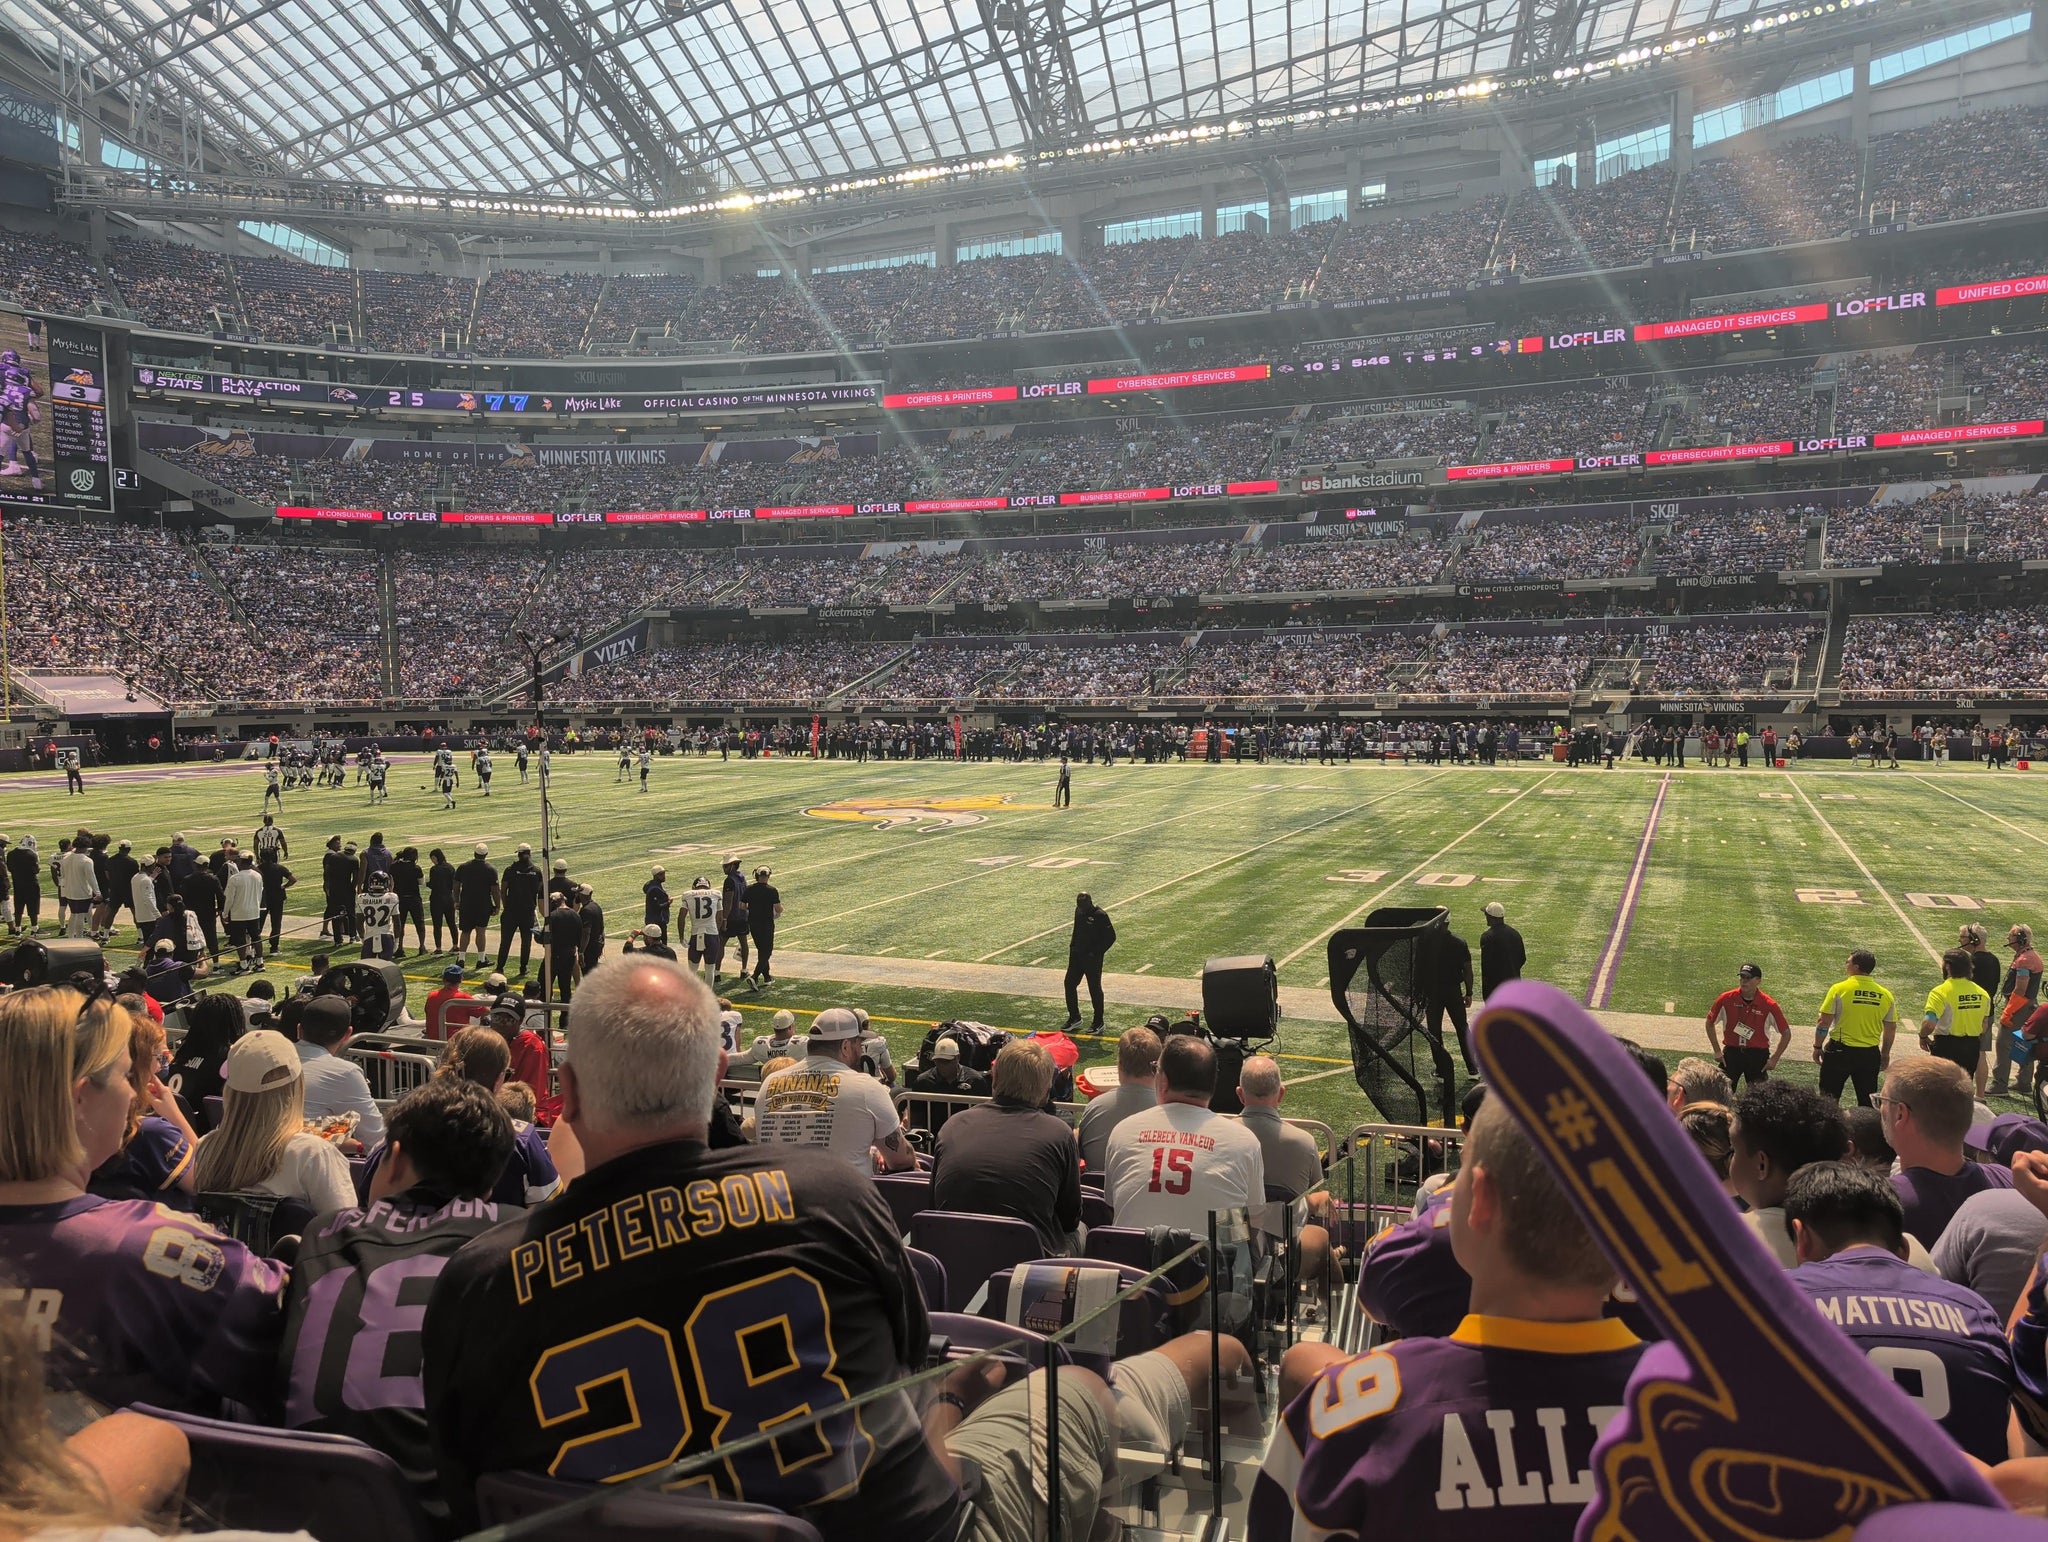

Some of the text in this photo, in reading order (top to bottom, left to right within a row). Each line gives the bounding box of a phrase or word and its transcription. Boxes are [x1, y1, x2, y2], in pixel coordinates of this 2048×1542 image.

[1869, 227, 1888, 236] ELLER
[1663, 253, 1701, 264] MARSHALL 70
[1958, 279, 2048, 300] UNIFIED COM
[1333, 300, 1365, 310] MINNESOTA
[1367, 297, 1389, 306] VIKINGS
[1836, 292, 1926, 317] LOFFLER
[1664, 311, 1796, 335] MANAGED IT SERVICES
[226, 334, 245, 342] BRYANT
[992, 332, 1008, 340] CARTER
[1550, 328, 1626, 349] LOFFLER
[52, 337, 98, 352] Mystic Lake
[1471, 346, 1482, 355] 3
[1304, 362, 1324, 372] 10
[1352, 356, 1390, 367] 5:46
[156, 377, 203, 390] STATS
[222, 378, 300, 392] PLAY ACTION
[1117, 370, 1236, 389] CYBERSECURITY SERVICES
[70, 386, 86, 399] 3
[222, 385, 262, 397] PLAYS
[1022, 382, 1081, 398] LOFFLER
[389, 391, 401, 406] 2
[411, 392, 424, 406] 5
[565, 397, 622, 411] Mystic Lake
[644, 397, 694, 408] OFFICIAL
[698, 396, 739, 407] CASINO
[766, 391, 828, 403] MINNESOTA
[831, 388, 876, 398] VIKINGS
[907, 395, 943, 404] COPIERS
[952, 391, 993, 402] PRINTERS
[1115, 418, 1141, 432] SKOL
[1901, 425, 2017, 442] MANAGED IT SERVICES
[57, 443, 87, 451] TURNOVERS
[90, 439, 106, 447] 7/63
[1799, 436, 1866, 451] LOFFLER
[403, 451, 442, 459] HOME
[453, 452, 468, 460] OF
[539, 449, 666, 466] MINNESOTA VIKINGS
[1660, 445, 1781, 461] CYBERSECURITY SERVICES
[1579, 455, 1639, 469] LOFFLER
[1466, 466, 1502, 476] COPIERS
[1511, 463, 1551, 472] PRINTERS
[117, 471, 138, 487] 21
[1115, 490, 1147, 500] SECURITY
[1174, 485, 1222, 497] LOFFLER
[915, 500, 998, 510] UNIFIED COMMUNICATIONS
[1011, 495, 1055, 506] LOFFLER
[709, 509, 751, 519] LOFFLER
[771, 508, 800, 516] MANAGED
[804, 505, 839, 515] SERVICES
[858, 503, 900, 513] LOFFLER
[325, 511, 372, 519] CONSULTING
[387, 511, 437, 521] LOFFLER
[557, 513, 602, 522] LOFFLER
[1306, 520, 1404, 537] MINNESOTA VIKINGS
[1084, 537, 1106, 550] SKOL
[1676, 575, 1756, 587] LAND LAKES INC.
[1474, 583, 1560, 594] TWIN CITIES ORTHOPEDICS
[819, 607, 876, 618] ticketmaster
[1646, 624, 1669, 636] SKOL
[1262, 632, 1362, 644] MINNESOTA VIKINGS
[594, 636, 637, 663] VIZZY
[1012, 642, 1032, 651] SKOL
[1660, 702, 1744, 712] MINNESOTA VIKINGS
[1956, 699, 1975, 709] SKOL
[374, 768, 385, 776] 29
[444, 768, 455, 776] 25
[1325, 869, 1481, 888] 30
[1794, 888, 1986, 910] 20
[694, 897, 712, 919] 13
[364, 906, 390, 927] 82
[1854, 990, 1883, 999] BEST
[1958, 994, 1983, 1002] BEST
[767, 1049, 787, 1058] MOORE
[766, 1074, 841, 1099] BANANAS
[809, 1095, 822, 1104] TOUR
[1138, 1130, 1215, 1151] CHLEBECK VANLEUR
[1148, 1148, 1194, 1195] 15
[510, 1169, 795, 1305] PETERSON
[142, 1225, 227, 1292] 8
[1815, 1294, 1970, 1338] MATTISON
[529, 1266, 875, 1505] 28
